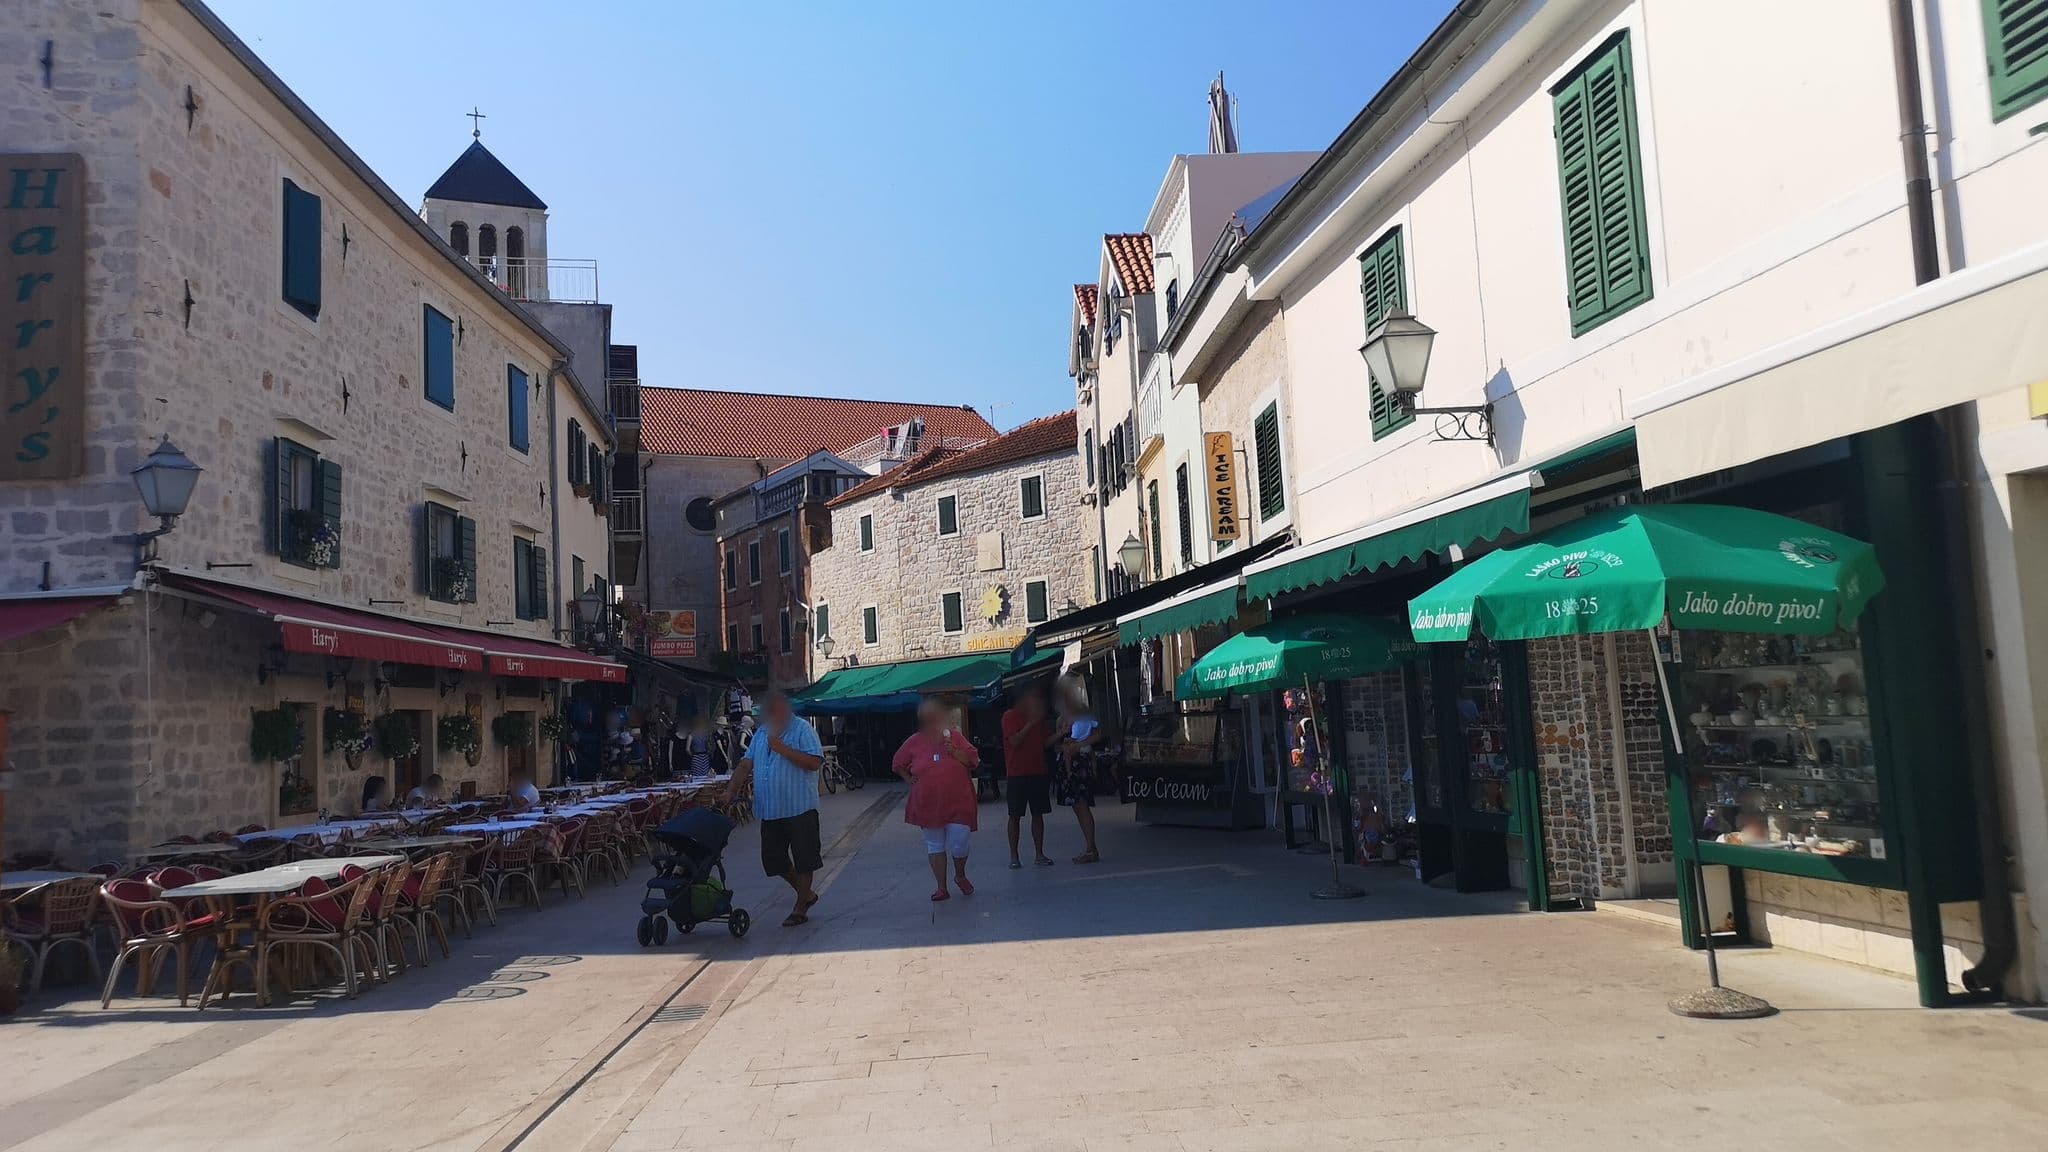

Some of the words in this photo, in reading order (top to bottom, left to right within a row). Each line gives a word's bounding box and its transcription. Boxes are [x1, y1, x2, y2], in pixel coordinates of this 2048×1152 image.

[1215, 454, 1230, 482] ICE
[1216, 487, 1235, 535] CREAM
[1525, 558, 1560, 577] LAŠKO
[1562, 550, 1588, 563] PIVO
[1411, 609, 1433, 630] Jako
[1434, 607, 1457, 627] dobro
[1546, 601, 1560, 618] 18
[1580, 597, 1598, 614] 25
[1679, 591, 1718, 615] Jako
[1722, 593, 1773, 616] dobro
[1774, 598, 1824, 625] pivo!
[653, 641, 675, 650] JUMBO
[676, 641, 694, 649] PIZZA
[1321, 648, 1331, 661] 18
[1340, 647, 1352, 658] 25
[1204, 666, 1227, 682] Jako
[1228, 661, 1254, 678] dobro
[1255, 654, 1278, 676] pivo!
[1127, 775, 1151, 797] Ice
[1155, 776, 1210, 801] Cream
